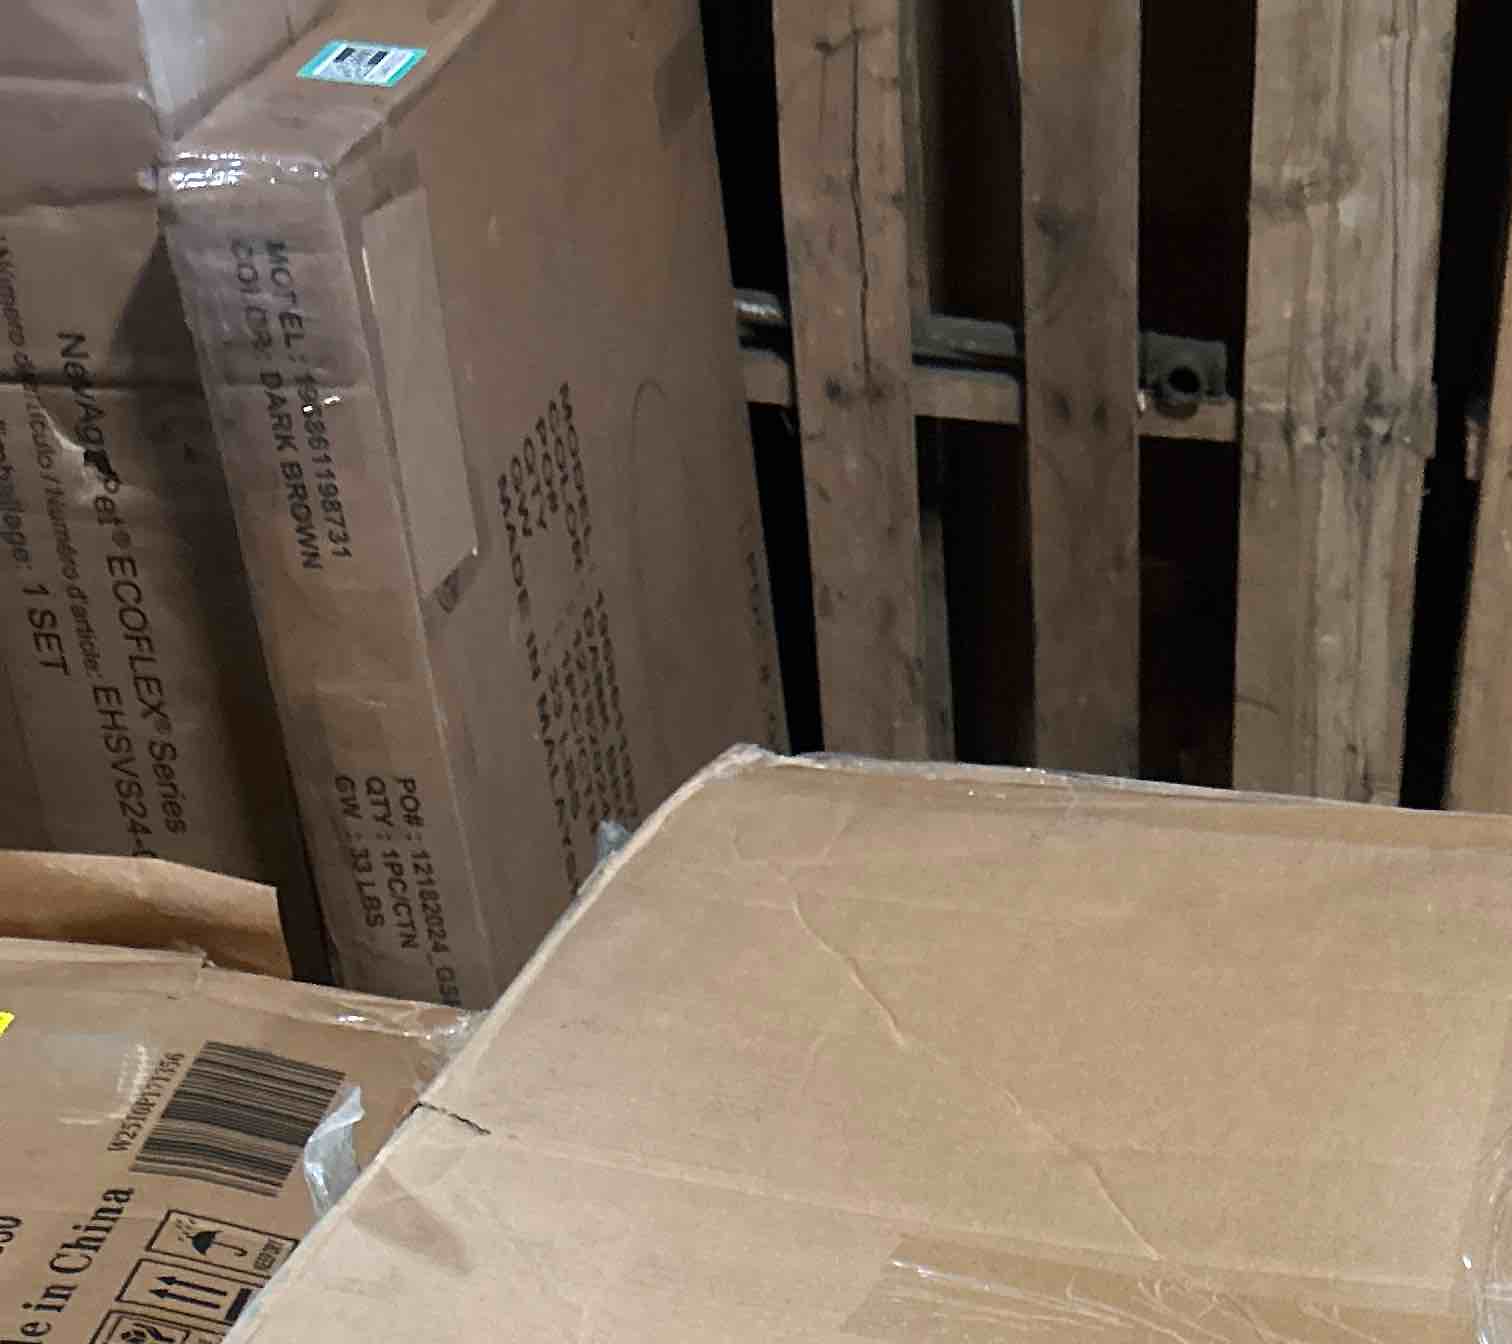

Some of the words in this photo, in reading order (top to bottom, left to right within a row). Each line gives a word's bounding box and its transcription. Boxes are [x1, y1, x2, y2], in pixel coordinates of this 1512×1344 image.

[259, 371, 298, 452] DARK
[279, 461, 325, 570] BROWN
[22, 582, 49, 597] 1
[28, 607, 70, 677] SET
[149, 740, 188, 836] Series
[334, 775, 363, 822] GW
[356, 878, 385, 928] LBS
[365, 775, 395, 829] QTY
[380, 848, 420, 951] 1PC/CTN
[49, 1187, 134, 1275] China
[21, 1284, 78, 1313] in
